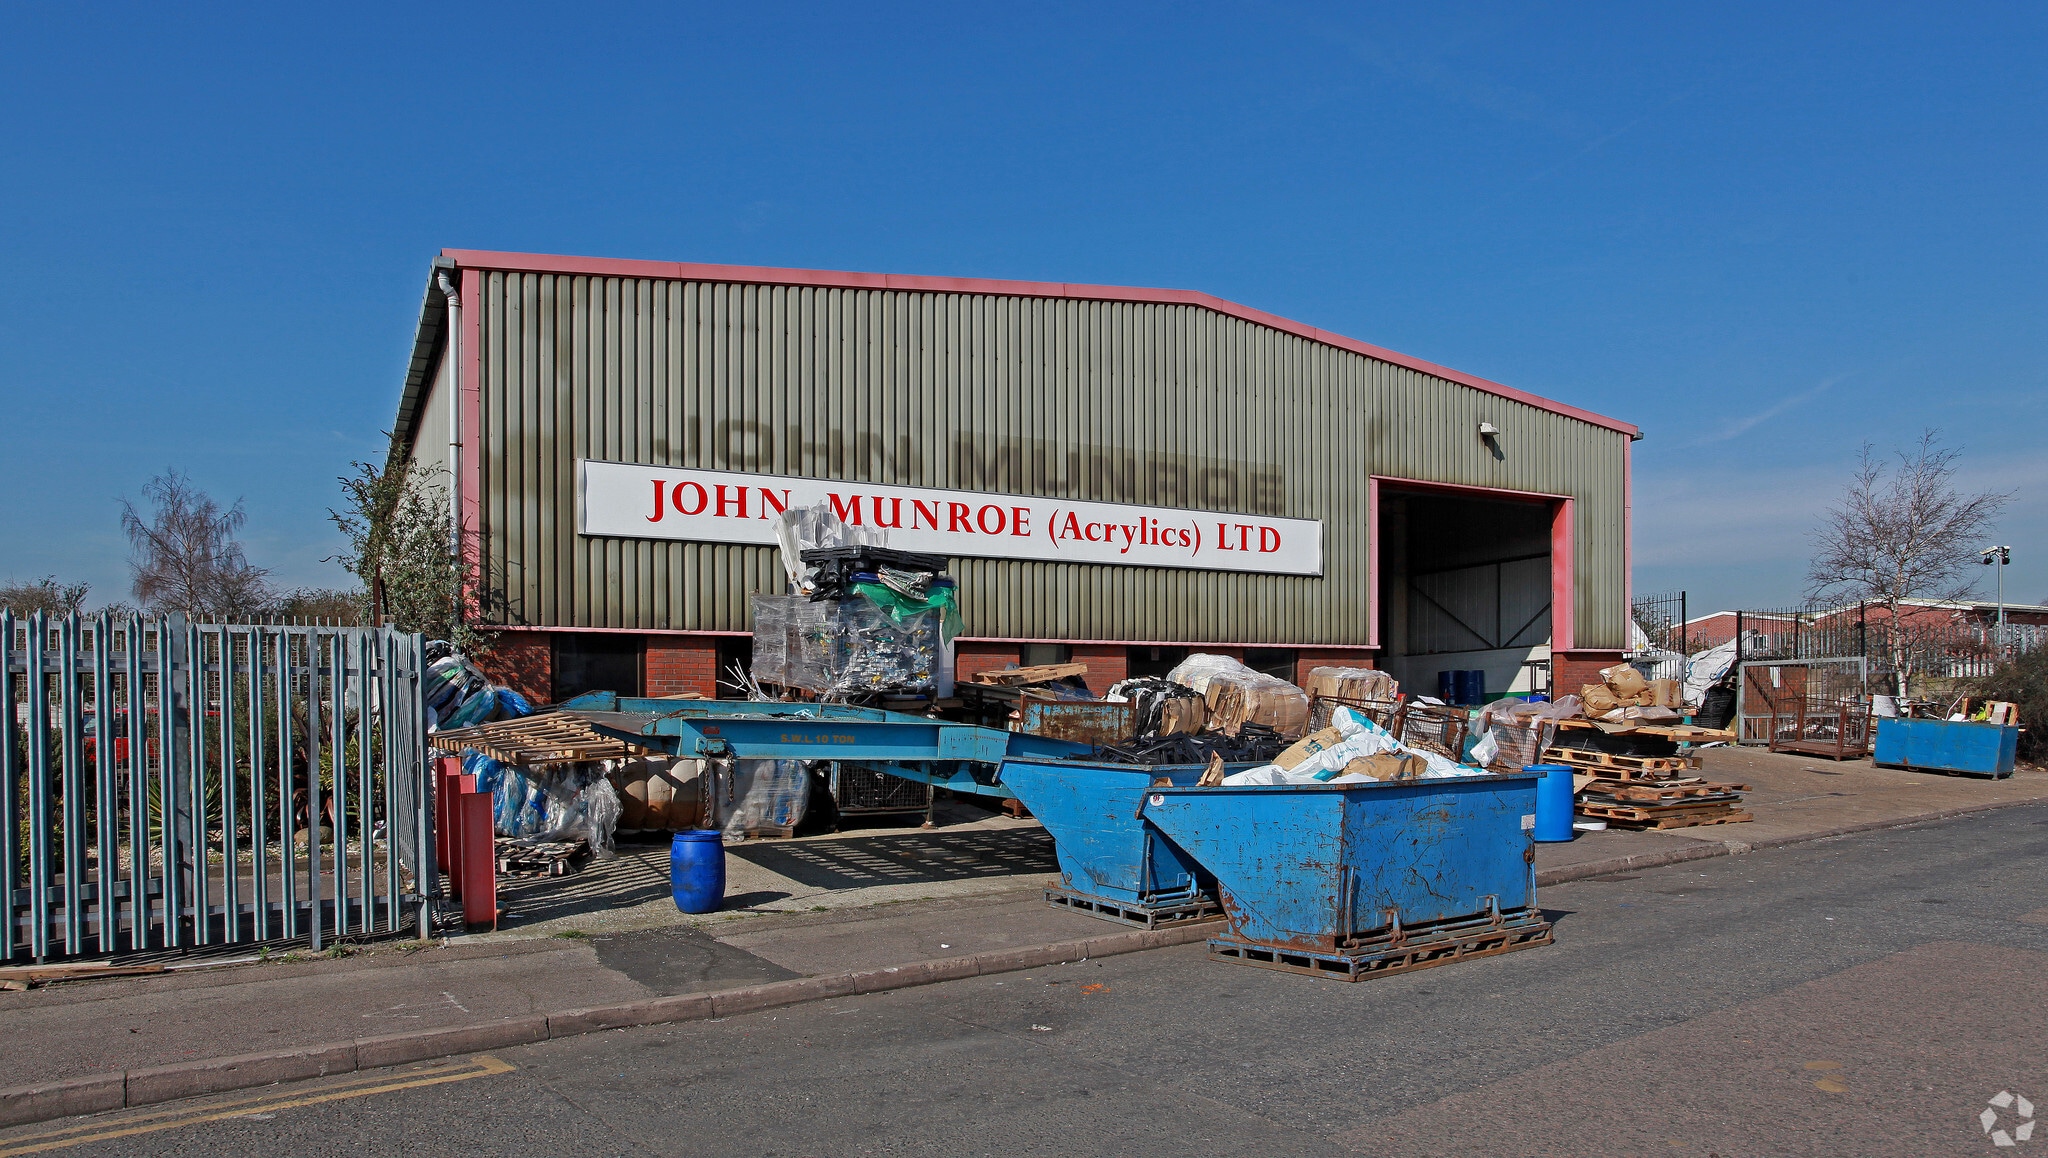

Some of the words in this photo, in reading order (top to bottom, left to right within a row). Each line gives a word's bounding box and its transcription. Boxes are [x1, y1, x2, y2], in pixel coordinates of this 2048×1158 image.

[646, 479, 792, 523] JOHN
[826, 492, 1032, 537] MUNROE
[1048, 510, 1201, 556] (Acrylics)
[1217, 523, 1282, 553] LTD
[816, 735, 829, 744] 10
[833, 735, 855, 744] TON
